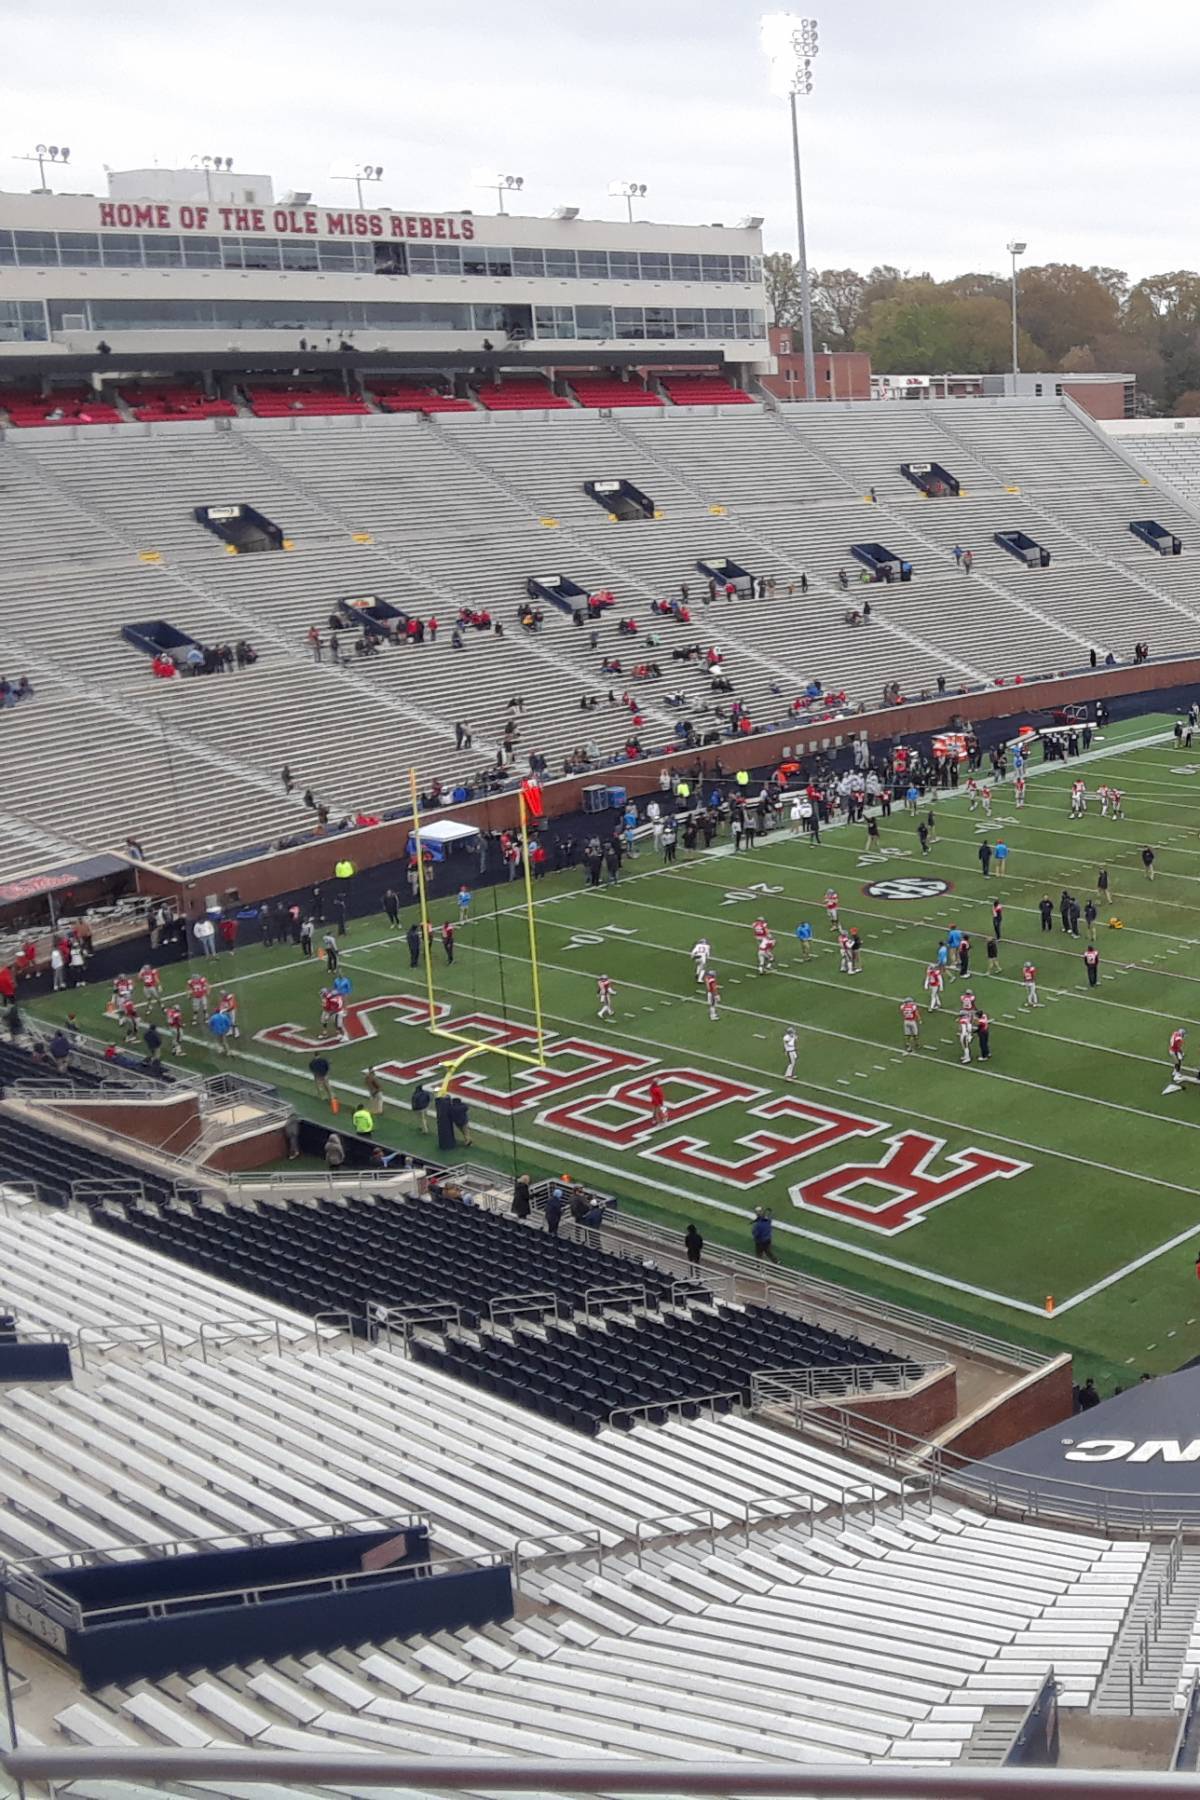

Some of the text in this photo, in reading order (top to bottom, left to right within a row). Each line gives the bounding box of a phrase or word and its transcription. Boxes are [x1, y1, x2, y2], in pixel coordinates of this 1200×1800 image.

[101, 202, 474, 240] HOME OF THE OLE MISS REBELS
[251, 994, 1034, 1236] REBELS
